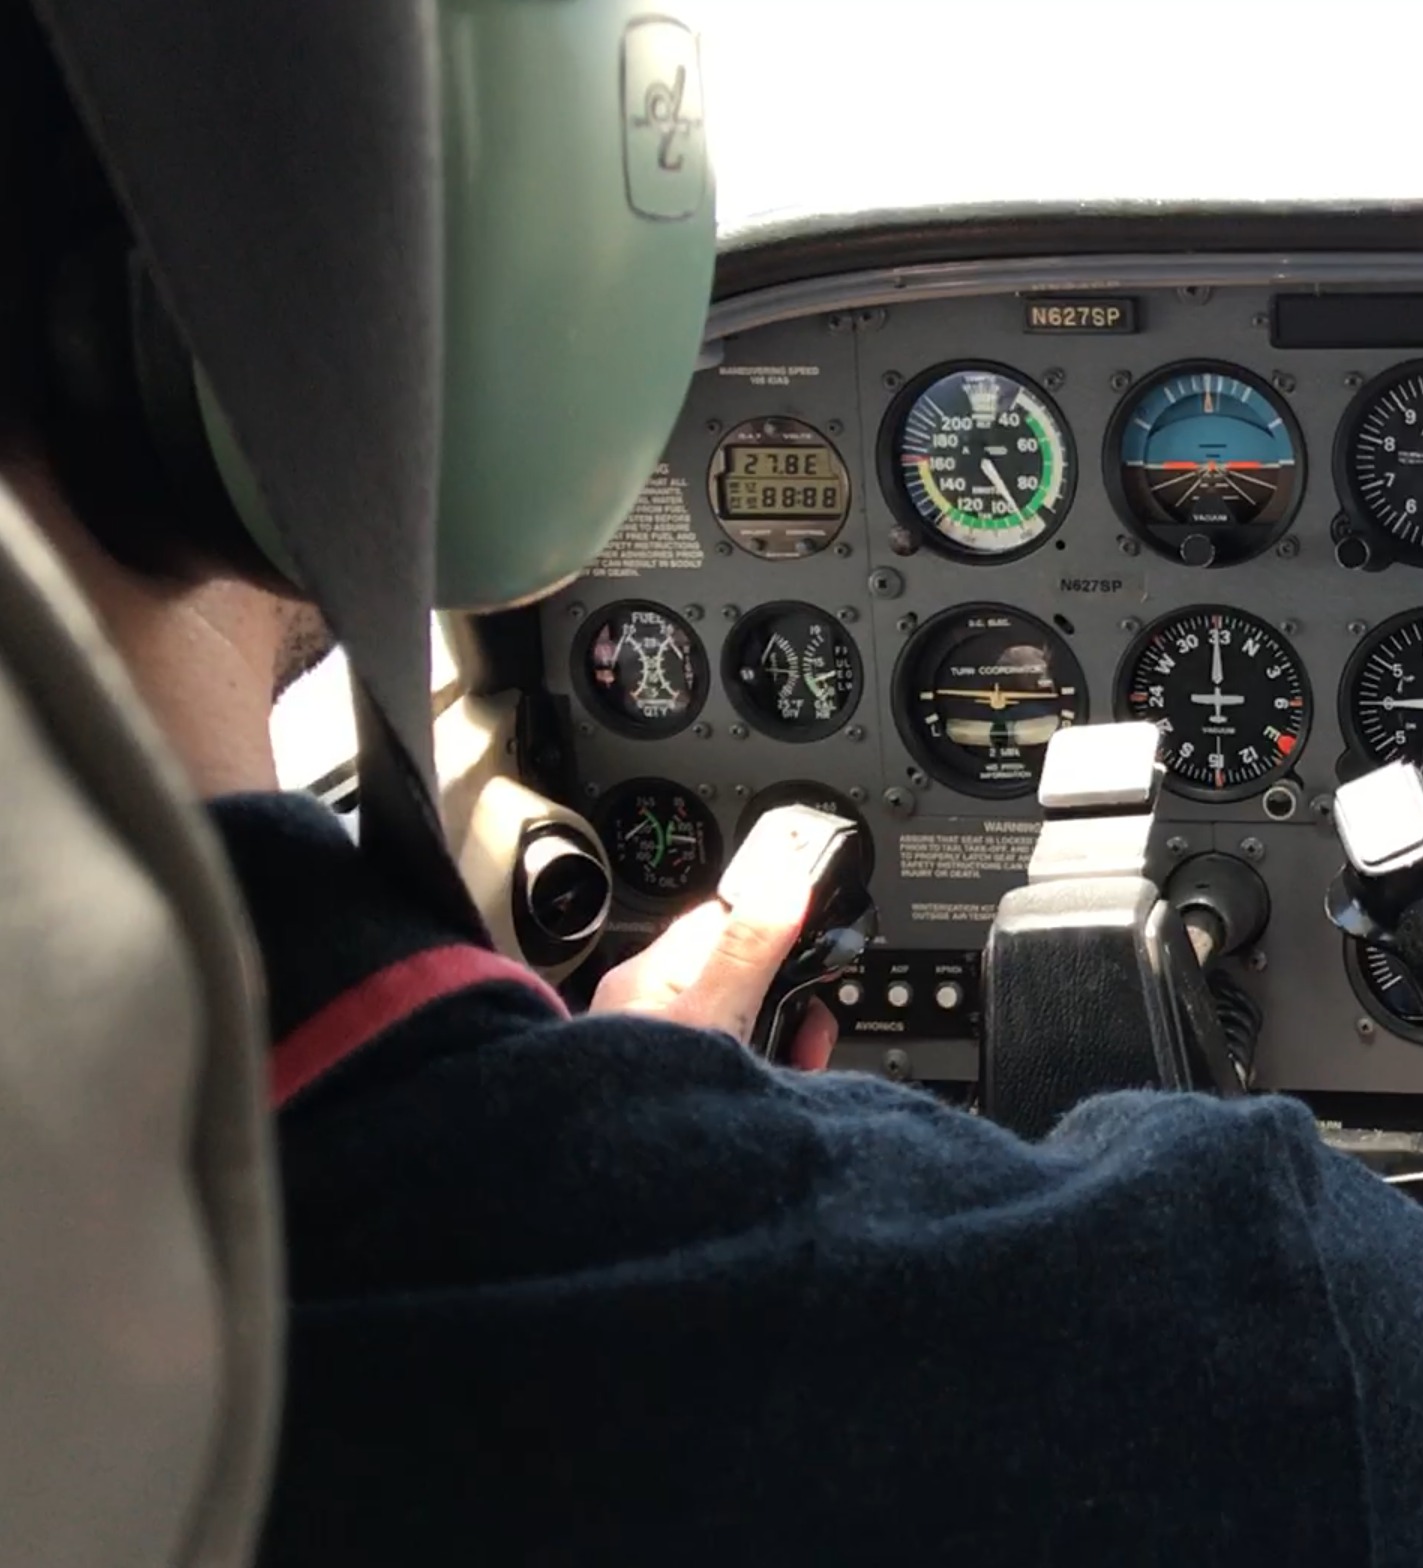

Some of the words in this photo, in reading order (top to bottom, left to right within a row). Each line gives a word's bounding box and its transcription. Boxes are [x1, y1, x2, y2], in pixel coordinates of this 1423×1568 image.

[1032, 307, 1120, 326] N627SP
[941, 417, 972, 430] 200
[998, 412, 1020, 426] 40
[1404, 409, 1416, 424] 9
[932, 434, 958, 447] 180
[1017, 438, 1038, 452] 60
[1383, 437, 1395, 451] 8
[744, 454, 817, 474] 27.8E
[930, 458, 955, 470] 160
[940, 478, 966, 491] 140
[1017, 476, 1038, 489] 80
[1385, 473, 1395, 487] 7
[958, 497, 983, 511] 120
[1405, 499, 1416, 513] 6
[1060, 579, 1122, 592] N627SP
[632, 612, 663, 624] FUEL
[1176, 634, 1199, 653] 30
[1208, 629, 1231, 645] 33
[1241, 638, 1261, 657] N
[1154, 653, 1176, 675] W
[1392, 664, 1403, 678] 5
[950, 667, 975, 676] TURN
[1266, 665, 1282, 678] 3
[1149, 685, 1164, 707] 24
[1274, 697, 1289, 709] 6
[643, 706, 668, 718] QTY
[931, 725, 941, 737] L
[1263, 725, 1280, 741] E
[1395, 730, 1406, 744] 5
[1208, 754, 1224, 768] 15
[1238, 746, 1258, 764] 12
[855, 1021, 904, 1032] AVIONICS
